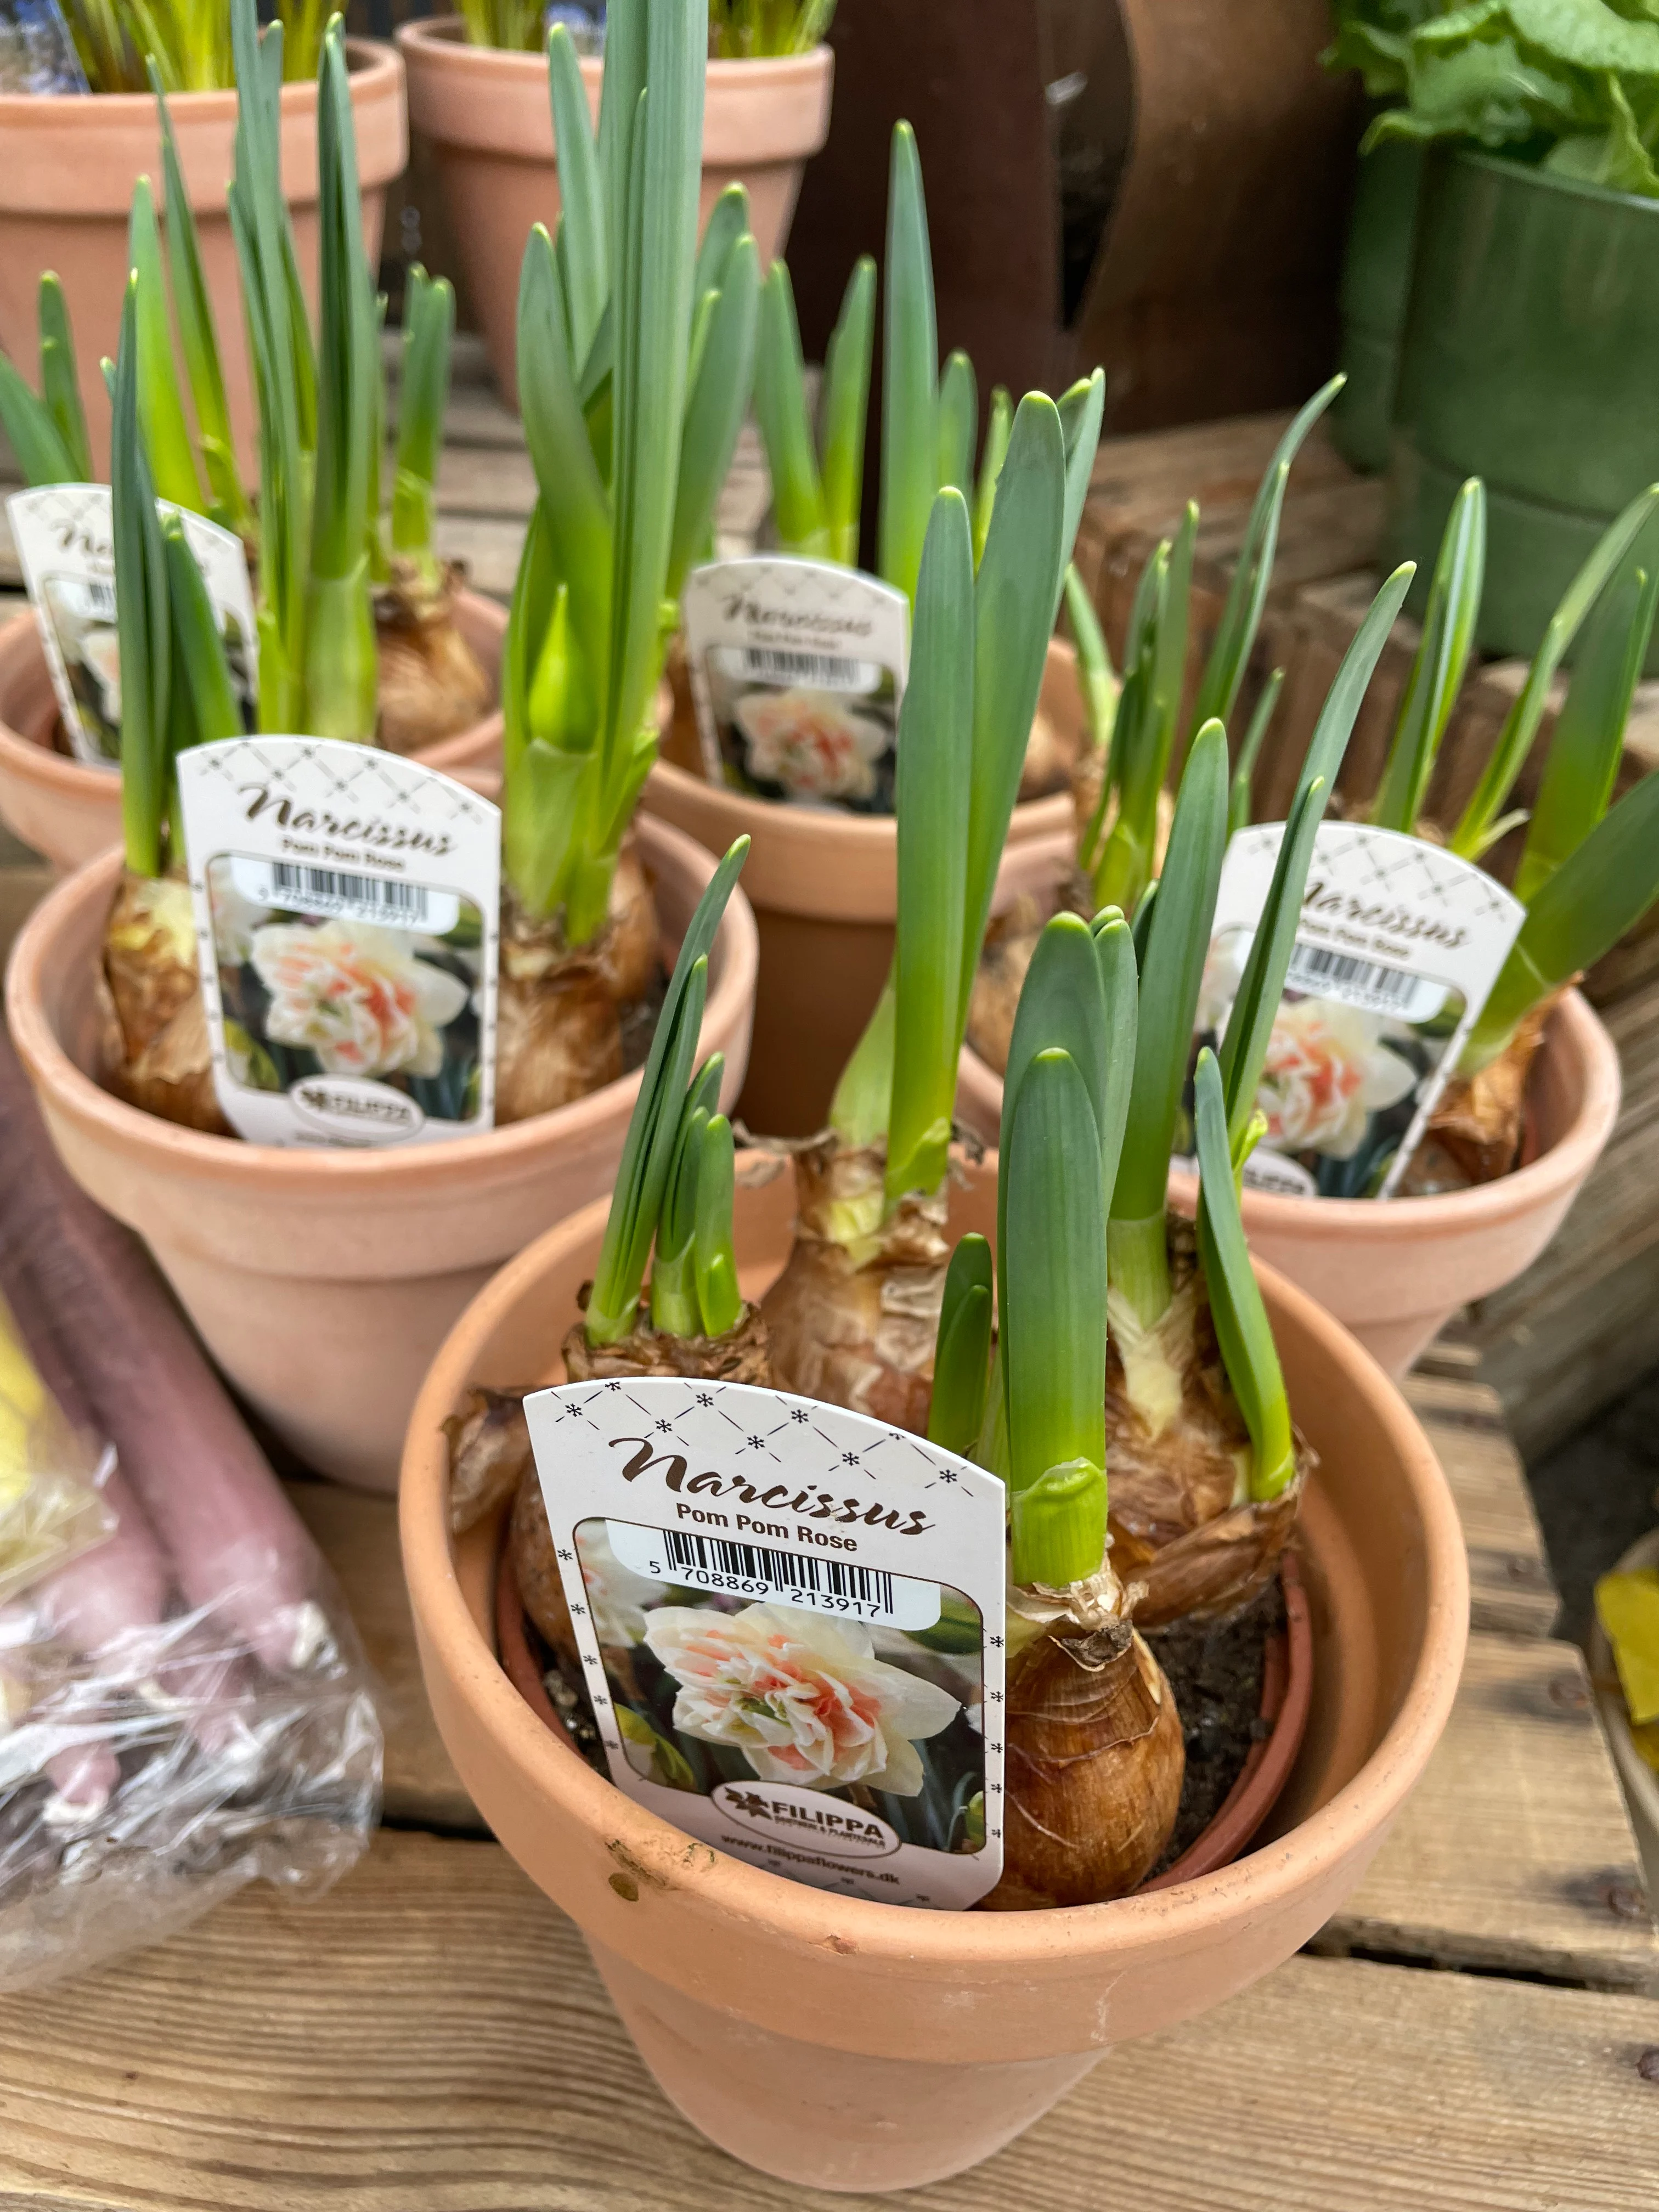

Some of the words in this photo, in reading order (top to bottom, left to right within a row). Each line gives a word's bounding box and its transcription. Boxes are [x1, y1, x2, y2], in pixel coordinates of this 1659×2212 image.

[238, 782, 456, 856] Narcissus
[608, 1437, 936, 1536] Narcissus
[676, 1502, 729, 1527] Pom
[736, 1514, 789, 1539] Pom
[797, 1525, 857, 1551] Rose
[649, 1560, 661, 1574] 5
[681, 1566, 769, 1595] 708869
[791, 1588, 881, 1617] 213917
[771, 1801, 884, 1838] FILIPPA
[721, 1835, 900, 1885] www.filippaflowers.dk
